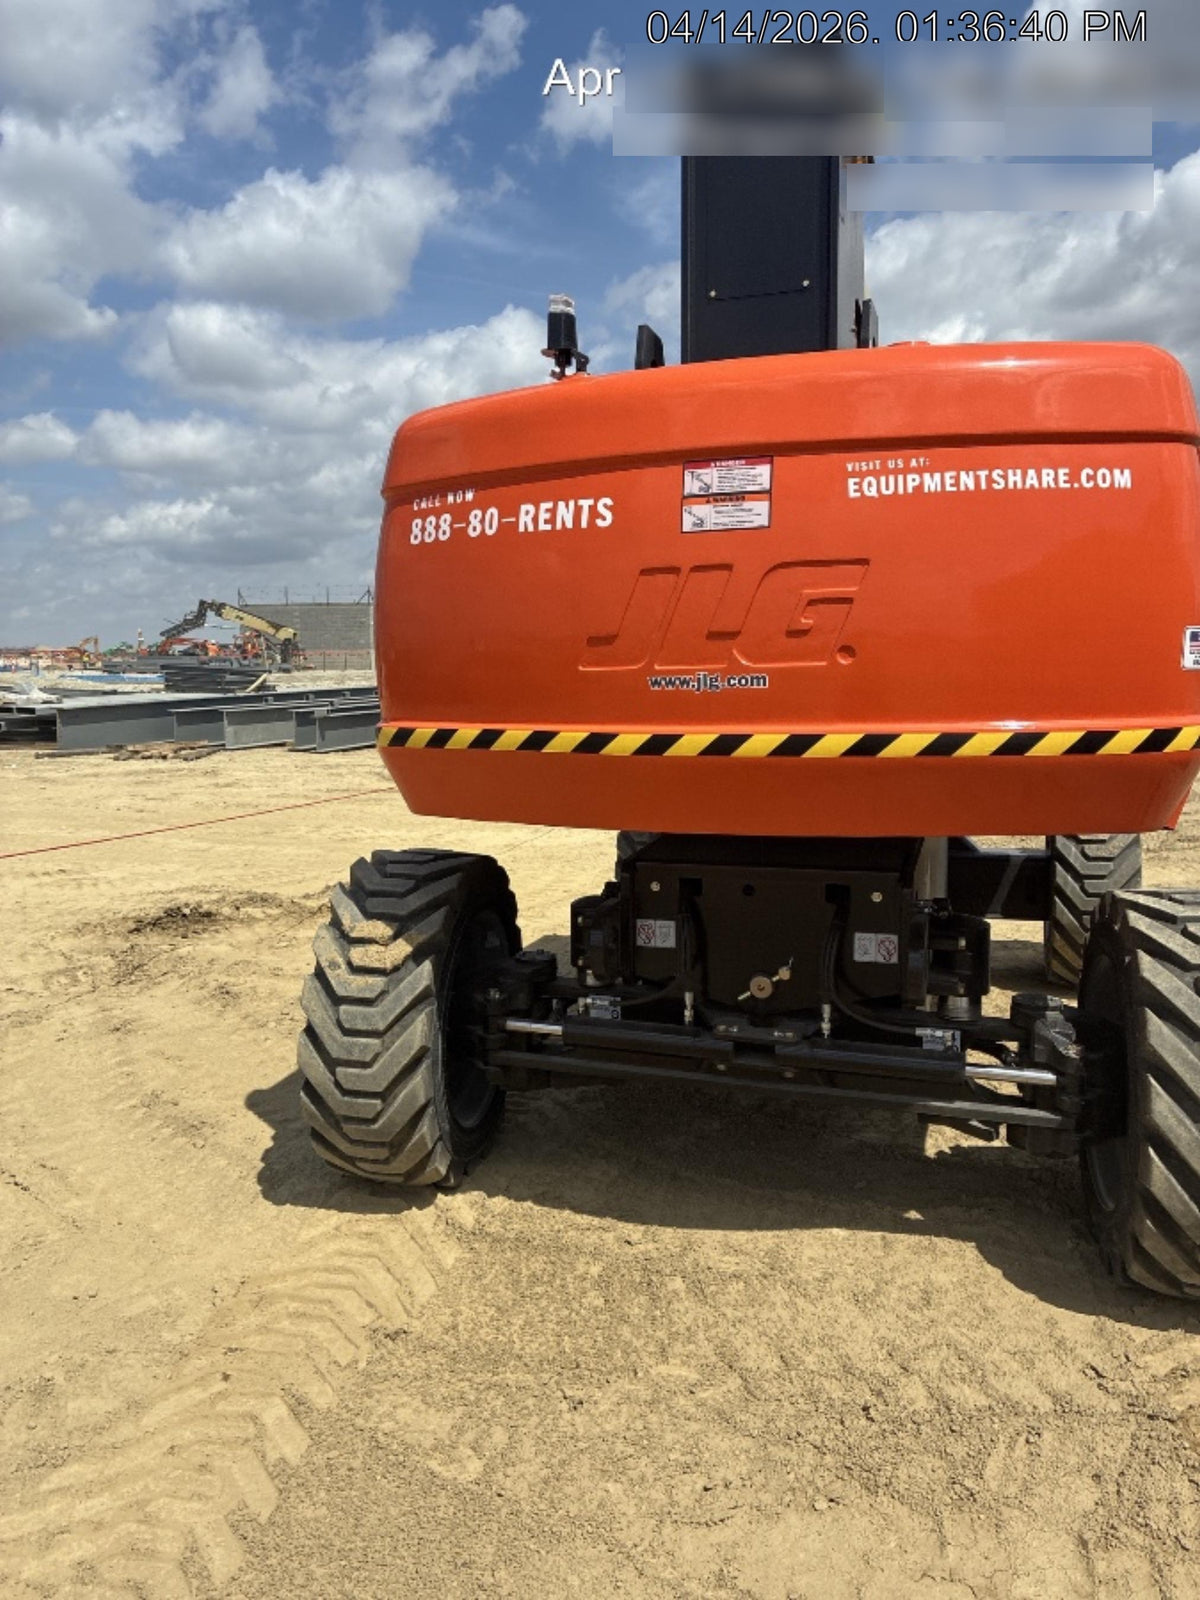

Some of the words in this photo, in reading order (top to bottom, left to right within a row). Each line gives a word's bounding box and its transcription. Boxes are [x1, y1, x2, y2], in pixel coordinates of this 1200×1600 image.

[846, 461, 881, 472] VISIT
[888, 459, 904, 469] US
[910, 457, 930, 468] AT:
[847, 468, 1132, 498] EQUIPMENTSHARE.COM
[413, 495, 442, 511] CALL
[447, 489, 475, 505] NOW
[409, 497, 614, 545] 888-80-RENTS
[648, 672, 768, 691] www.jlg.com
